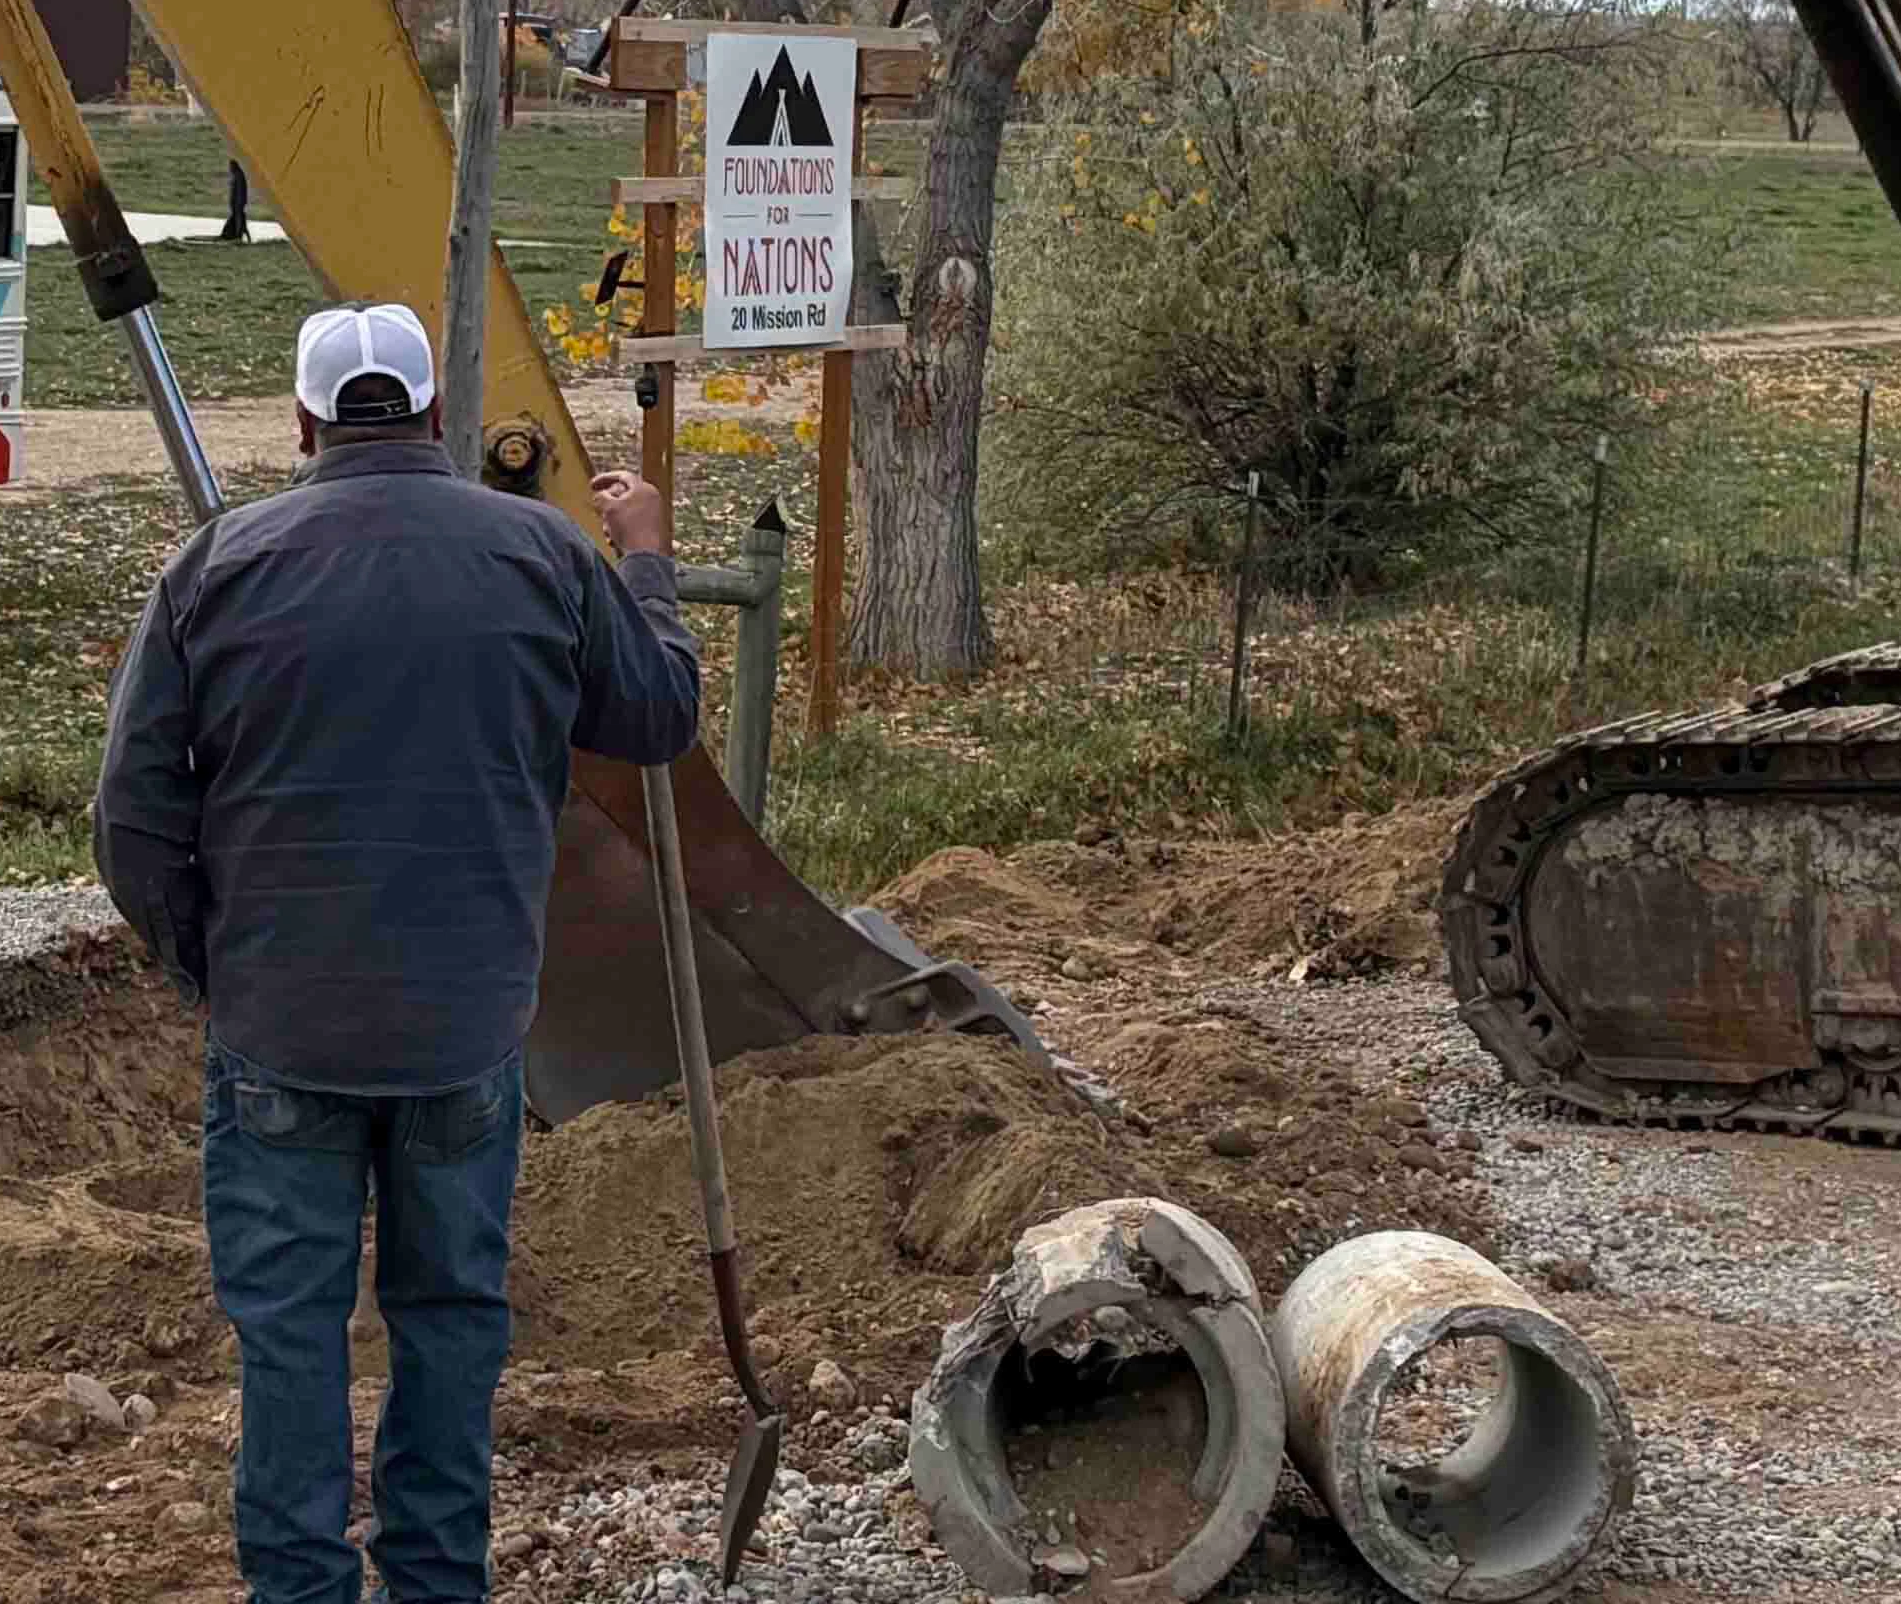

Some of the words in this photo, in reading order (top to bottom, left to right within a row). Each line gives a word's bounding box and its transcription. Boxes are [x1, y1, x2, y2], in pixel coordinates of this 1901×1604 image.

[723, 156, 834, 196] FOUNDATIONS
[766, 206, 790, 225] FOR
[723, 236, 834, 296] NATIONS
[731, 306, 747, 331] 20
[752, 303, 803, 331] Mission
[807, 301, 826, 327] Rd
